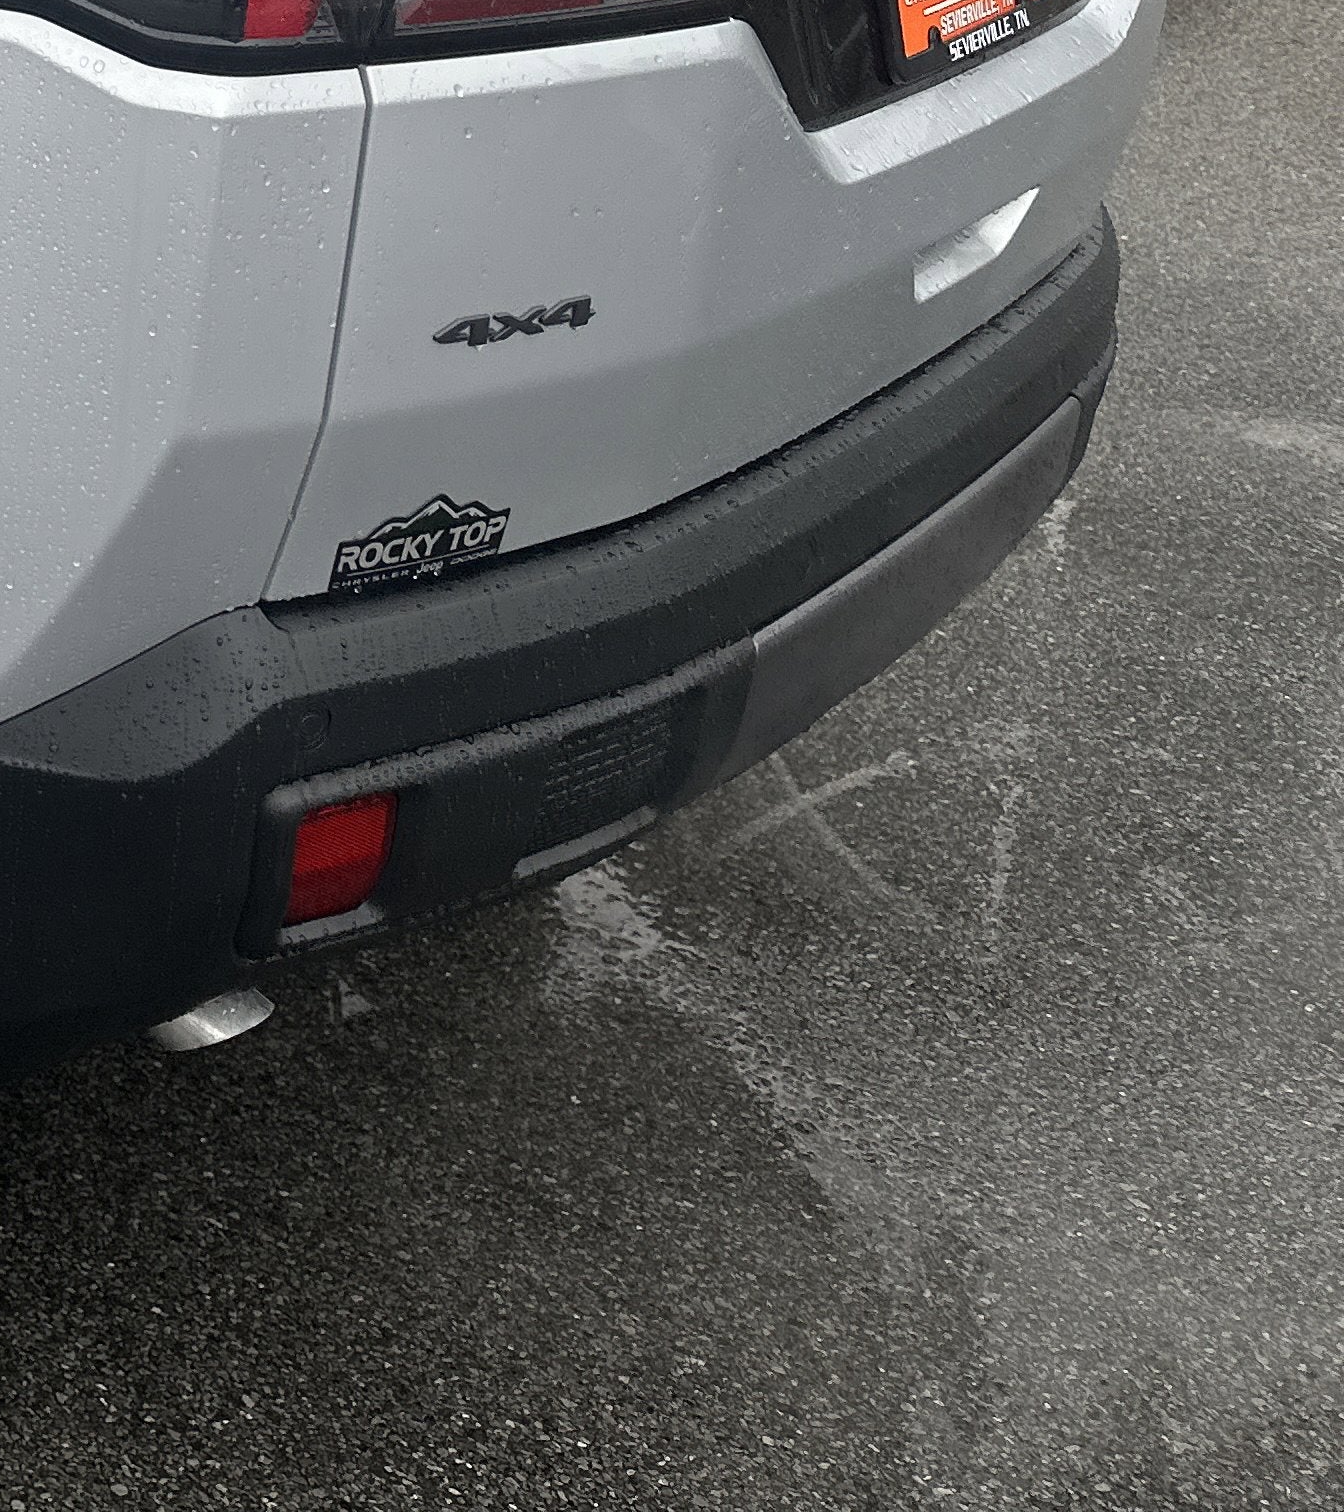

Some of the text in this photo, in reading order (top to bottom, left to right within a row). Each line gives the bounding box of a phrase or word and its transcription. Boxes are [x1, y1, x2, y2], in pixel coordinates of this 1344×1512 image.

[432, 295, 596, 349] 4x4
[337, 515, 508, 574] ROCKY TOP
[331, 569, 410, 589] CHRYSLER
[416, 560, 444, 574] Jeep
